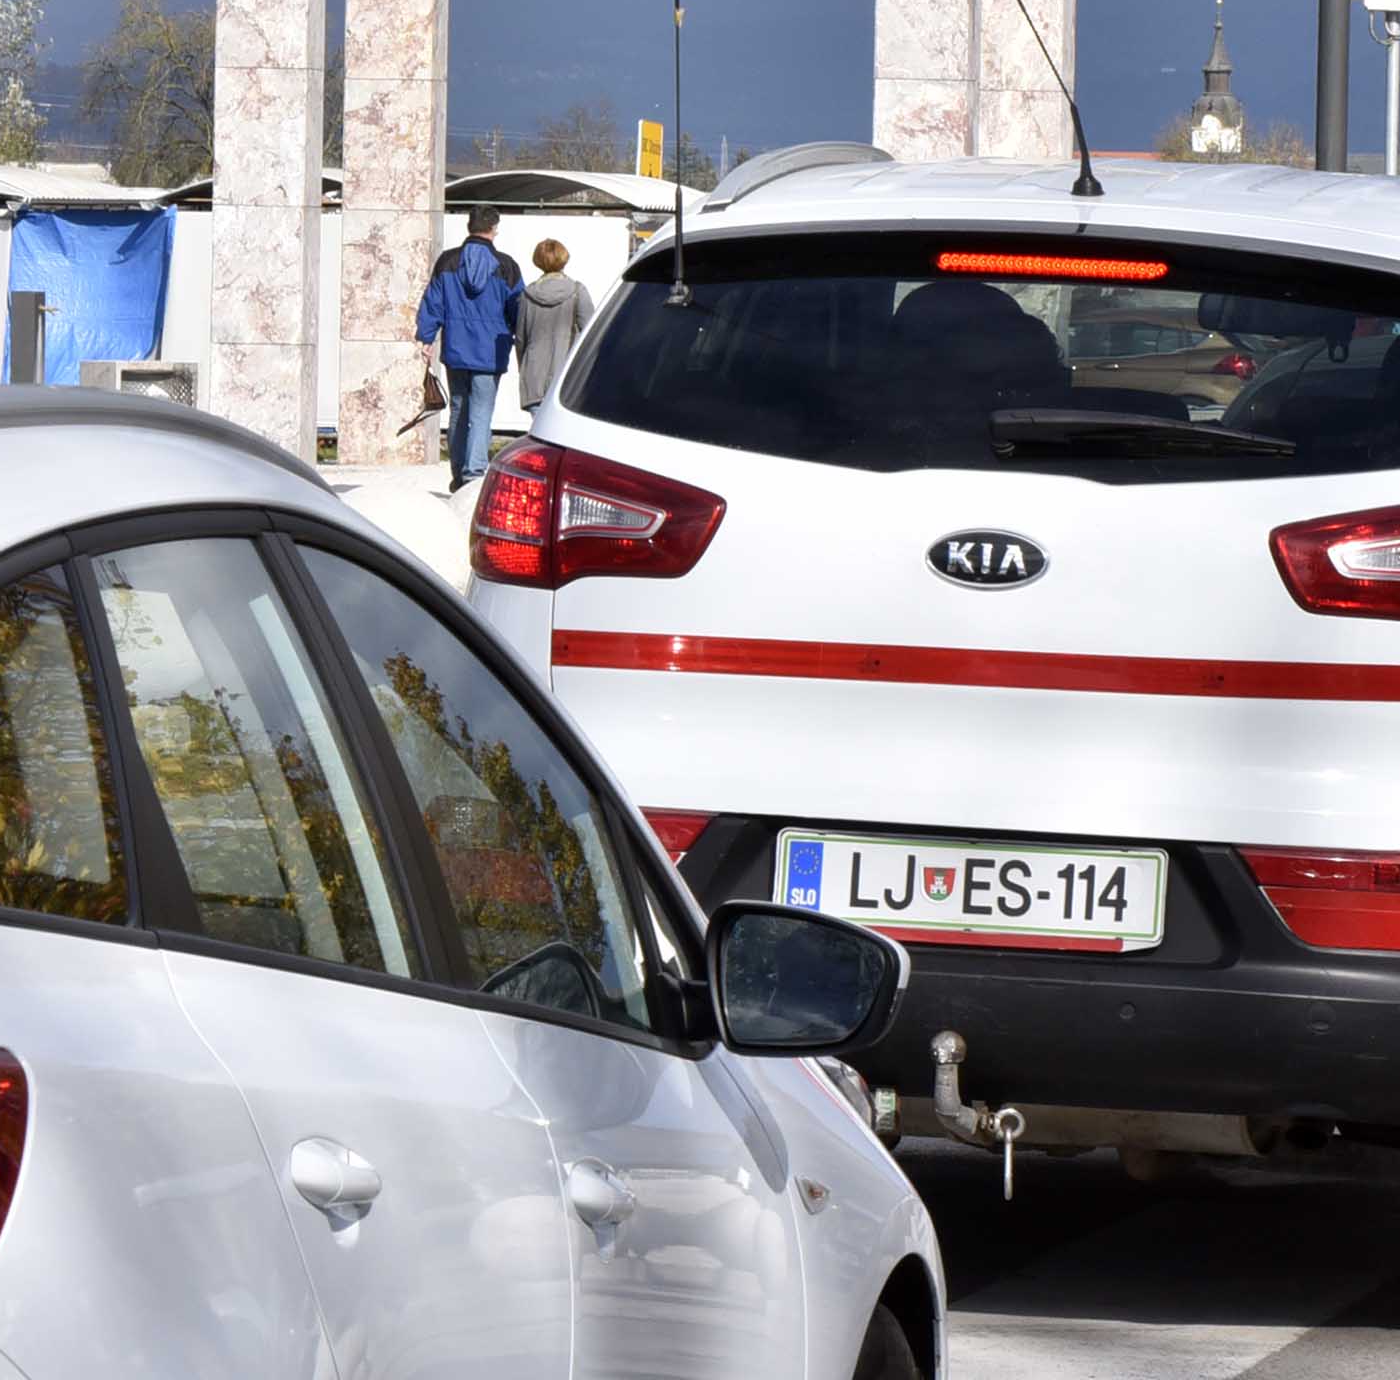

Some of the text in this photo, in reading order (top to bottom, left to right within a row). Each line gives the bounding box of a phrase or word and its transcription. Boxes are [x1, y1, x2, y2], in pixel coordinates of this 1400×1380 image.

[946, 540, 1028, 576] KIA
[790, 887, 818, 907] SLO
[849, 851, 1128, 922] LJ ES-114
